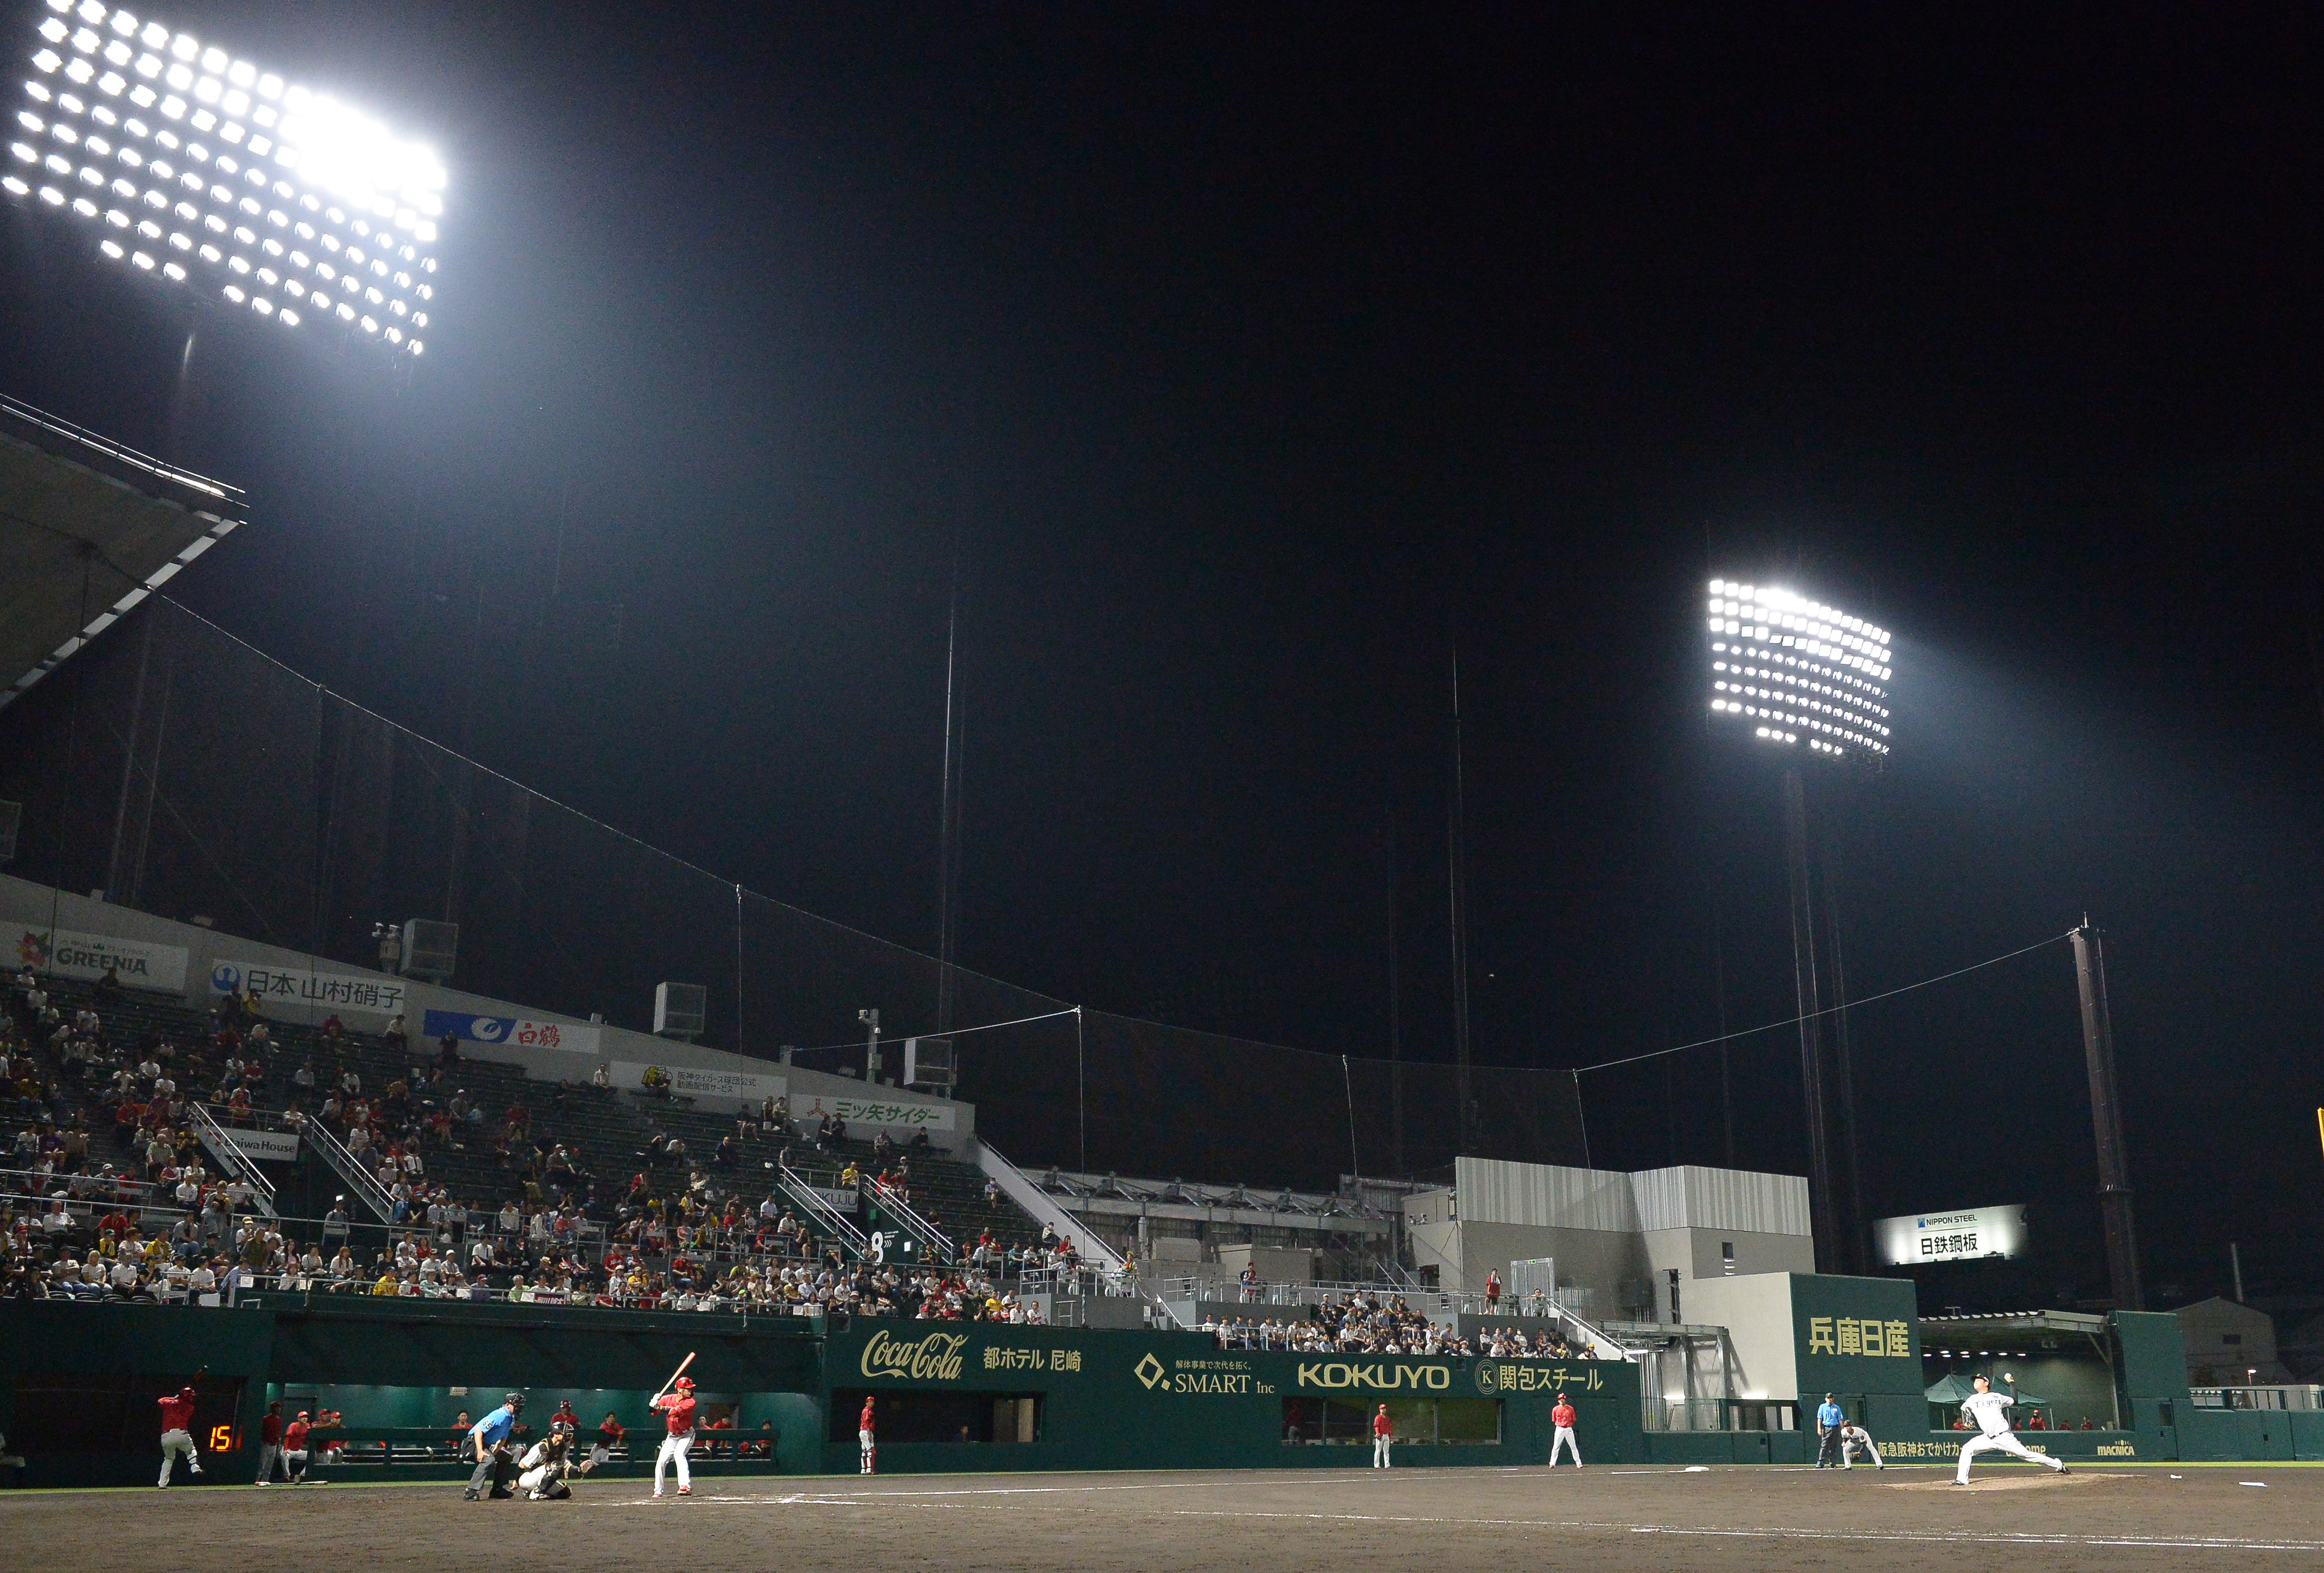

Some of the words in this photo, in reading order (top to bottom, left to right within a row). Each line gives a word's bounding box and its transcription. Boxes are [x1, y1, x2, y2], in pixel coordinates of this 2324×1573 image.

[57, 947, 149, 976] GREENIA
[247, 970, 403, 1008] 日本山村硝子
[518, 1022, 561, 1047] 白鶴
[833, 1101, 940, 1124] 三ツ矢サイダー
[225, 1137, 259, 1150] Daiwa
[261, 1141, 295, 1153] House
[1926, 1217, 1952, 1226] NIPPON
[1954, 1214, 1977, 1223] STEEL
[1921, 1233, 1978, 1255] 日鉄鋼板
[1809, 1317, 1910, 1357] 兵庫日産
[861, 1330, 969, 1379] Coca-Cola
[984, 1346, 1044, 1369] 都ホテル
[1050, 1350, 1081, 1372] 尼崎
[1175, 1360, 1251, 1370] 解体事業で次代を拓く。
[1175, 1374, 1251, 1393] SMART
[1257, 1381, 1275, 1393] inc
[1298, 1363, 1450, 1389] KOKUYO
[1499, 1365, 1603, 1391] 関包スチール
[210, 1426, 231, 1450] 15
